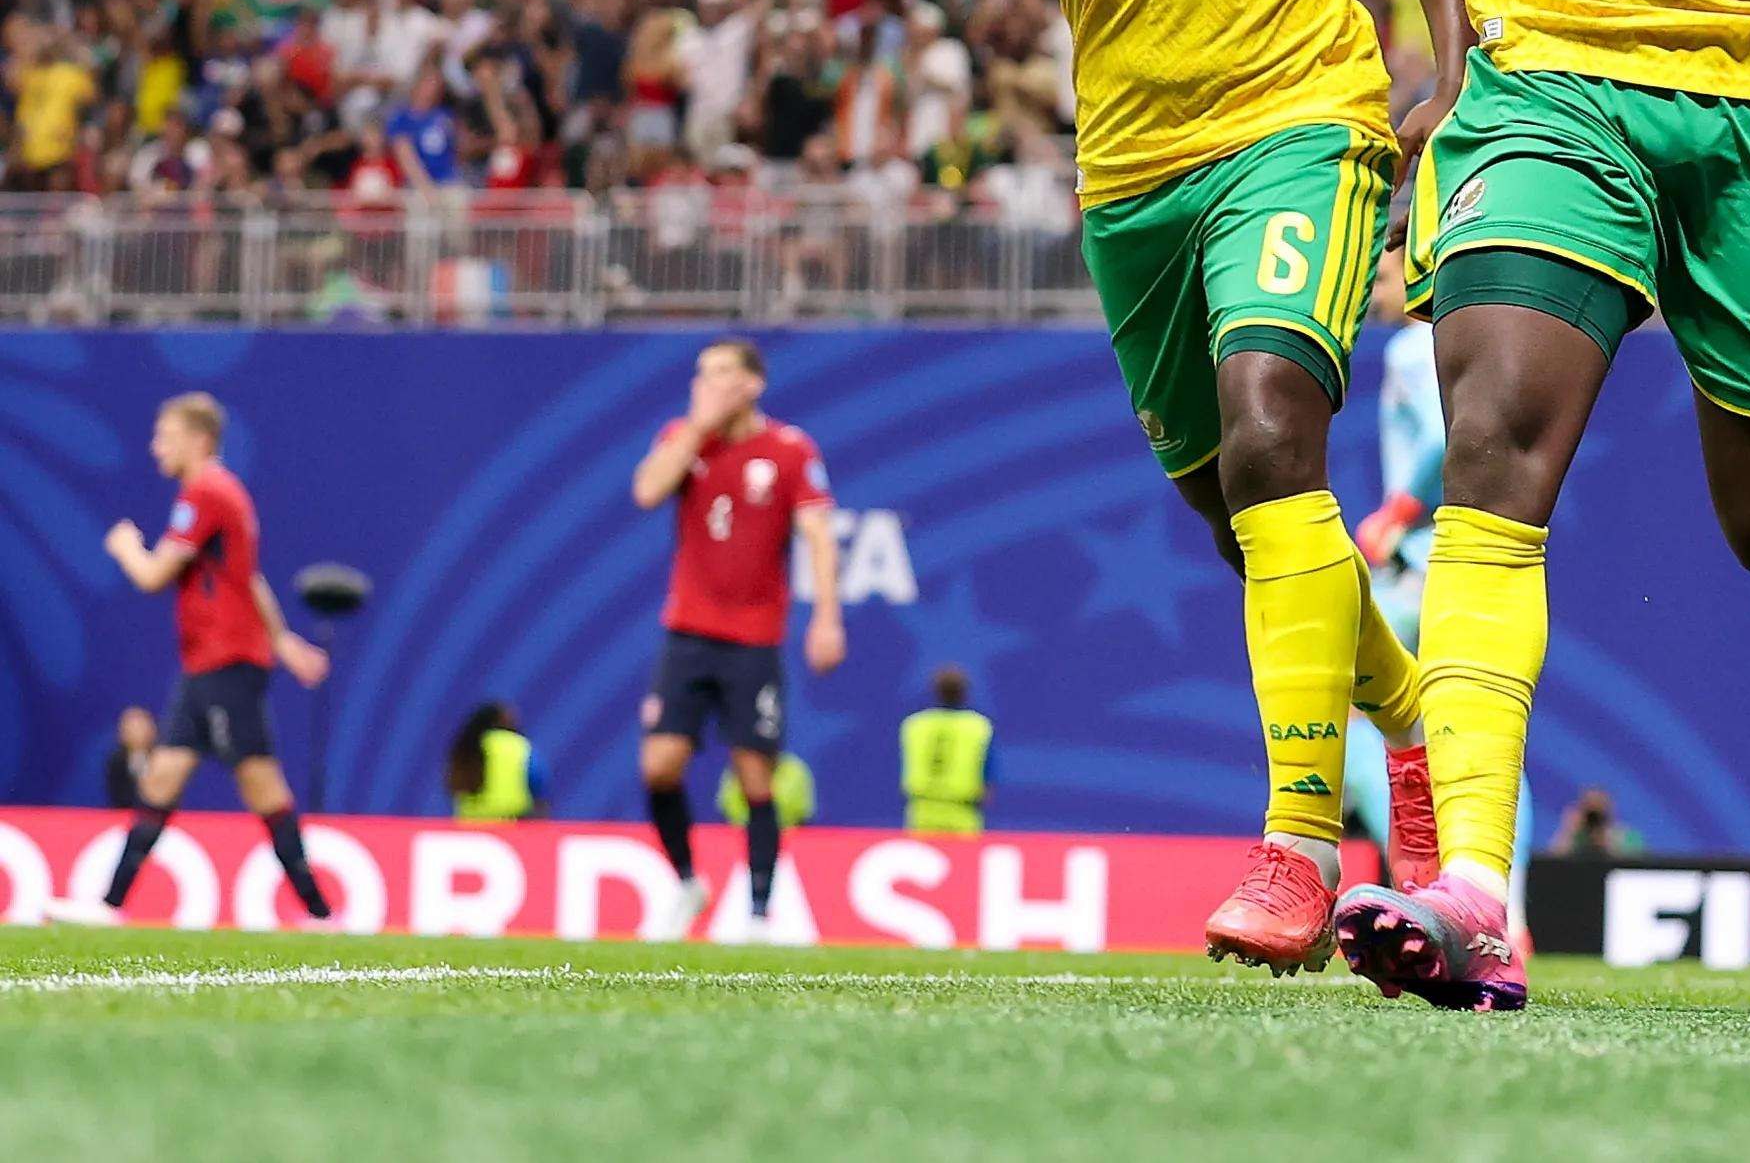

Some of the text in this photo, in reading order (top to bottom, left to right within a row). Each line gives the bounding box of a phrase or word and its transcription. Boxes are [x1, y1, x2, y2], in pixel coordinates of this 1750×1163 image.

[1256, 211, 1317, 296] 6
[790, 508, 920, 605] FA
[1269, 722, 1339, 741] SAFA
